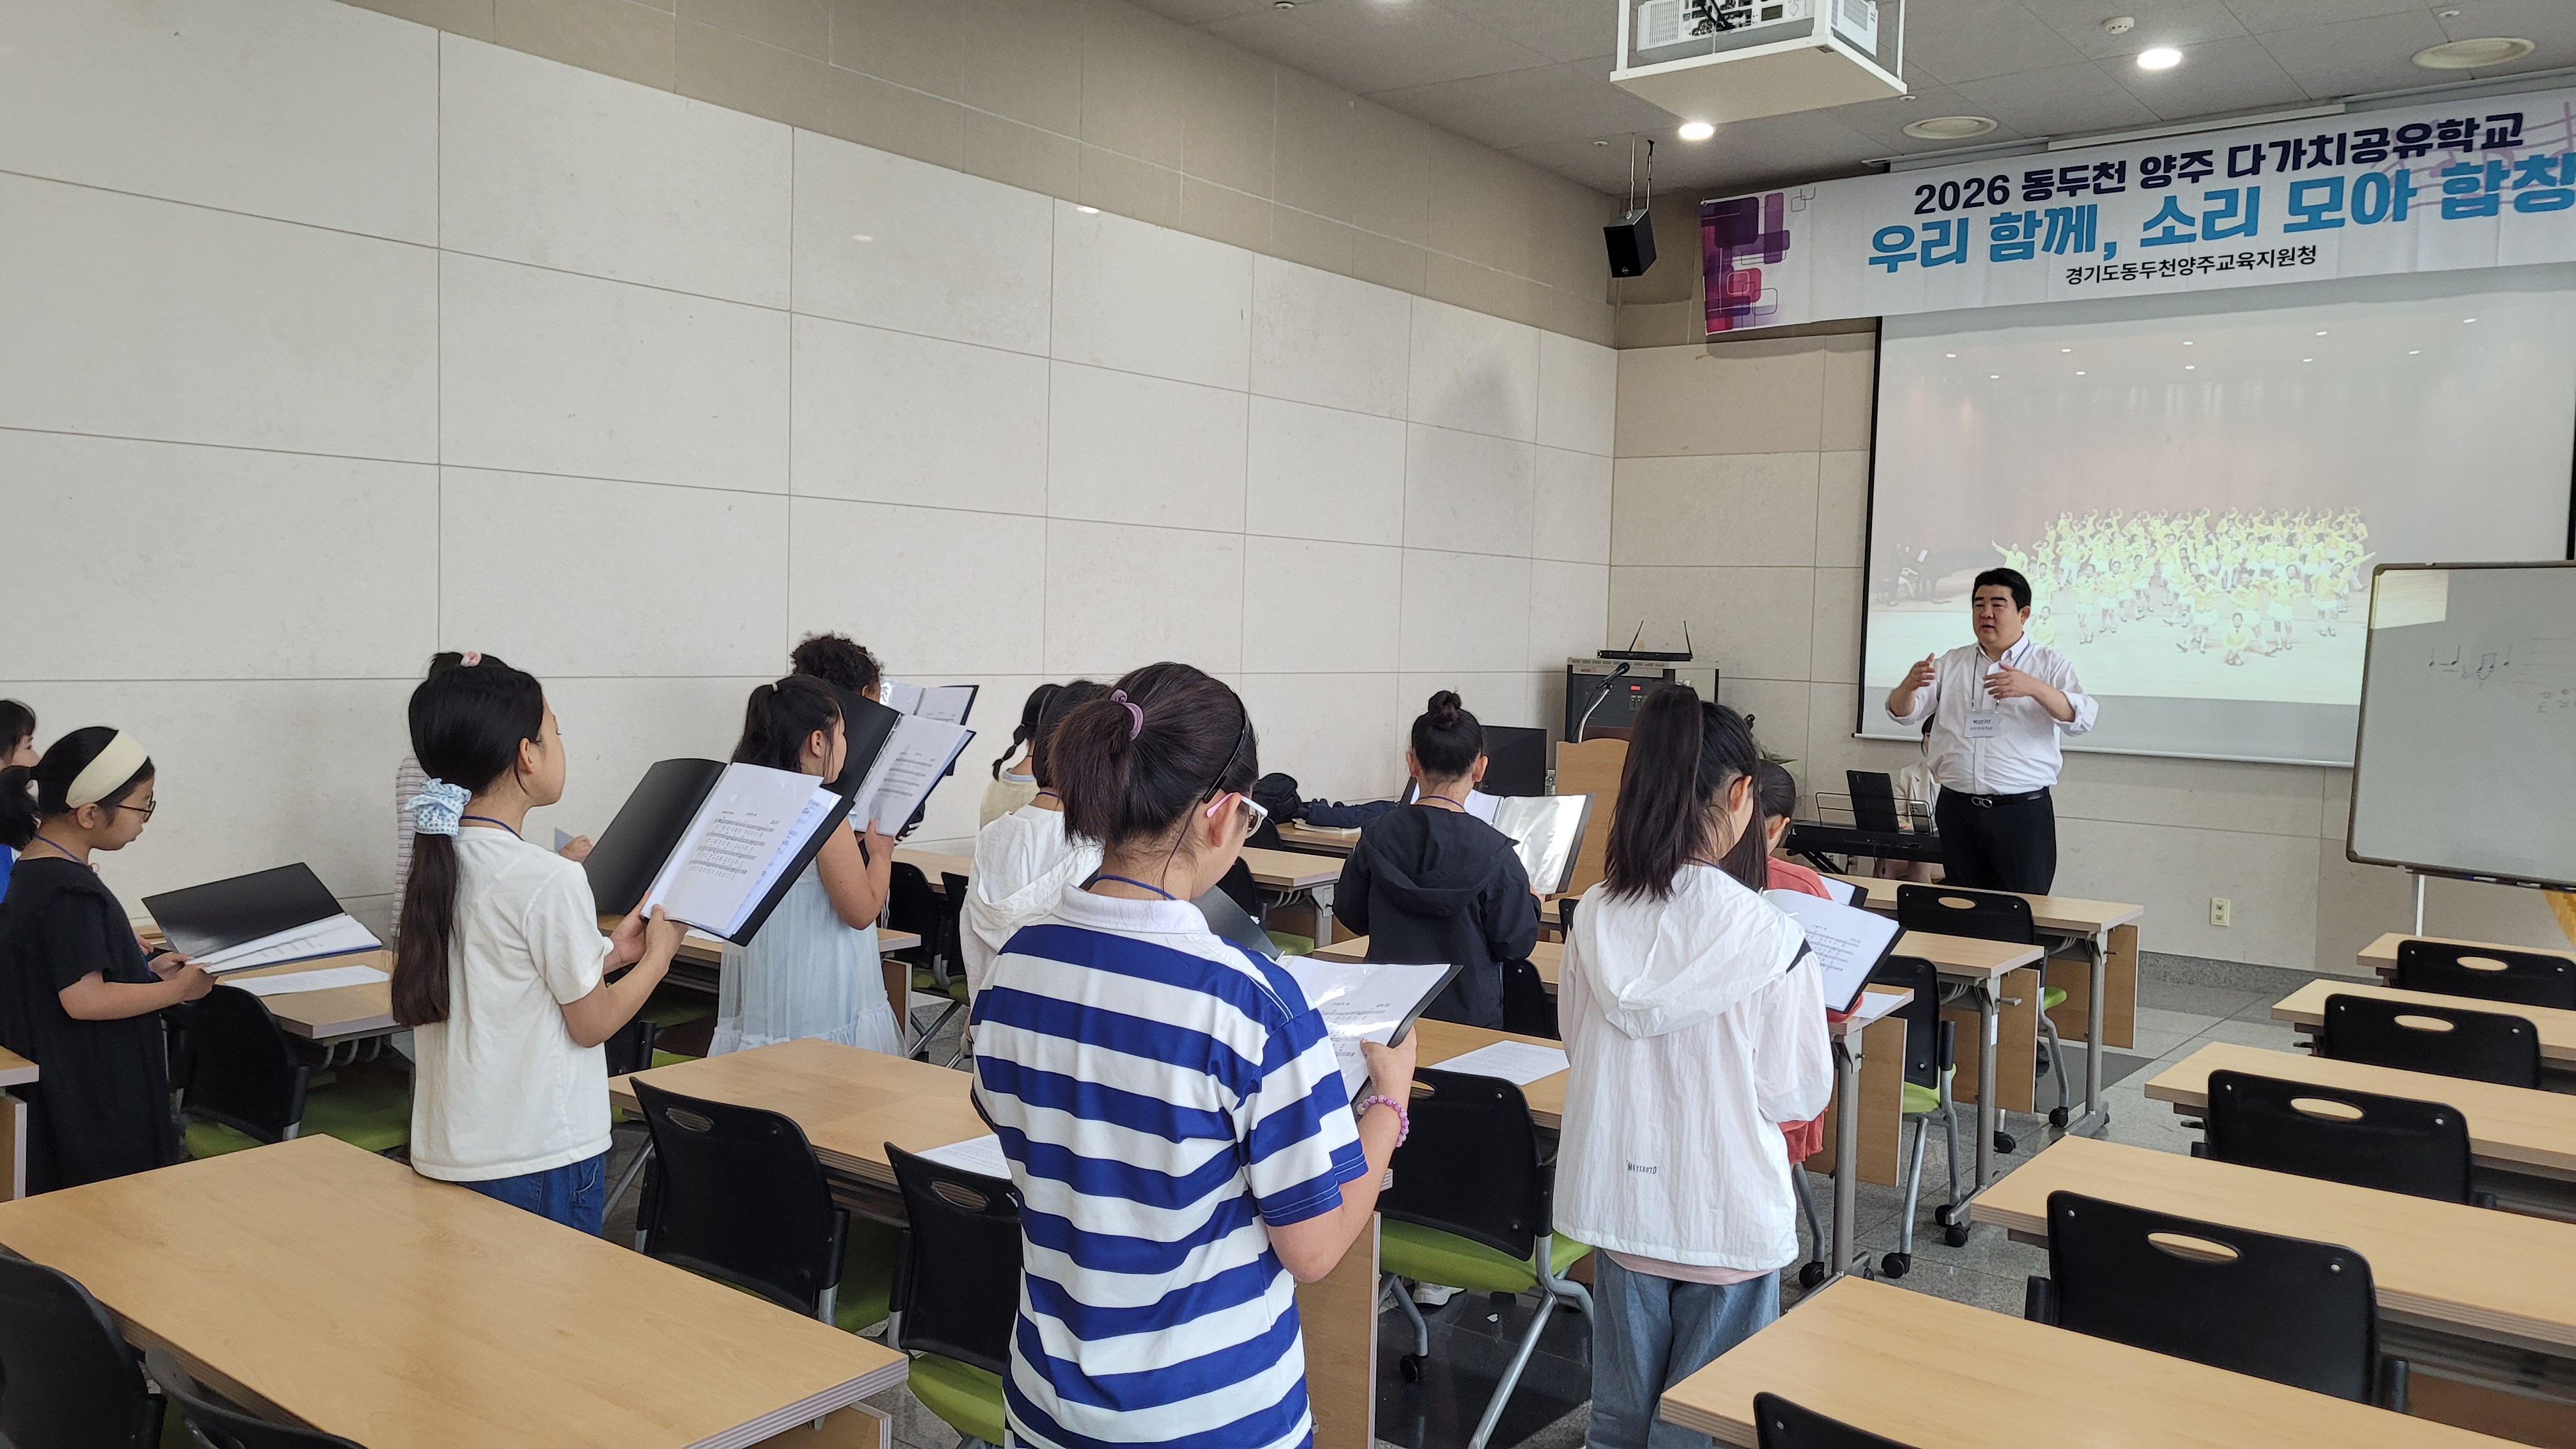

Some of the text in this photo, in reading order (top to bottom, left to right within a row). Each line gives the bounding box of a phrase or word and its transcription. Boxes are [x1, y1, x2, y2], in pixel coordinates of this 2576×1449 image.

[1868, 152, 2576, 273] 우리 함께, 소리 모아 합창
[1914, 112, 2524, 215] 2026 동두천 양주 다가치공유학교
[2065, 245, 2317, 285] 경기도동두천양주교육지원청
